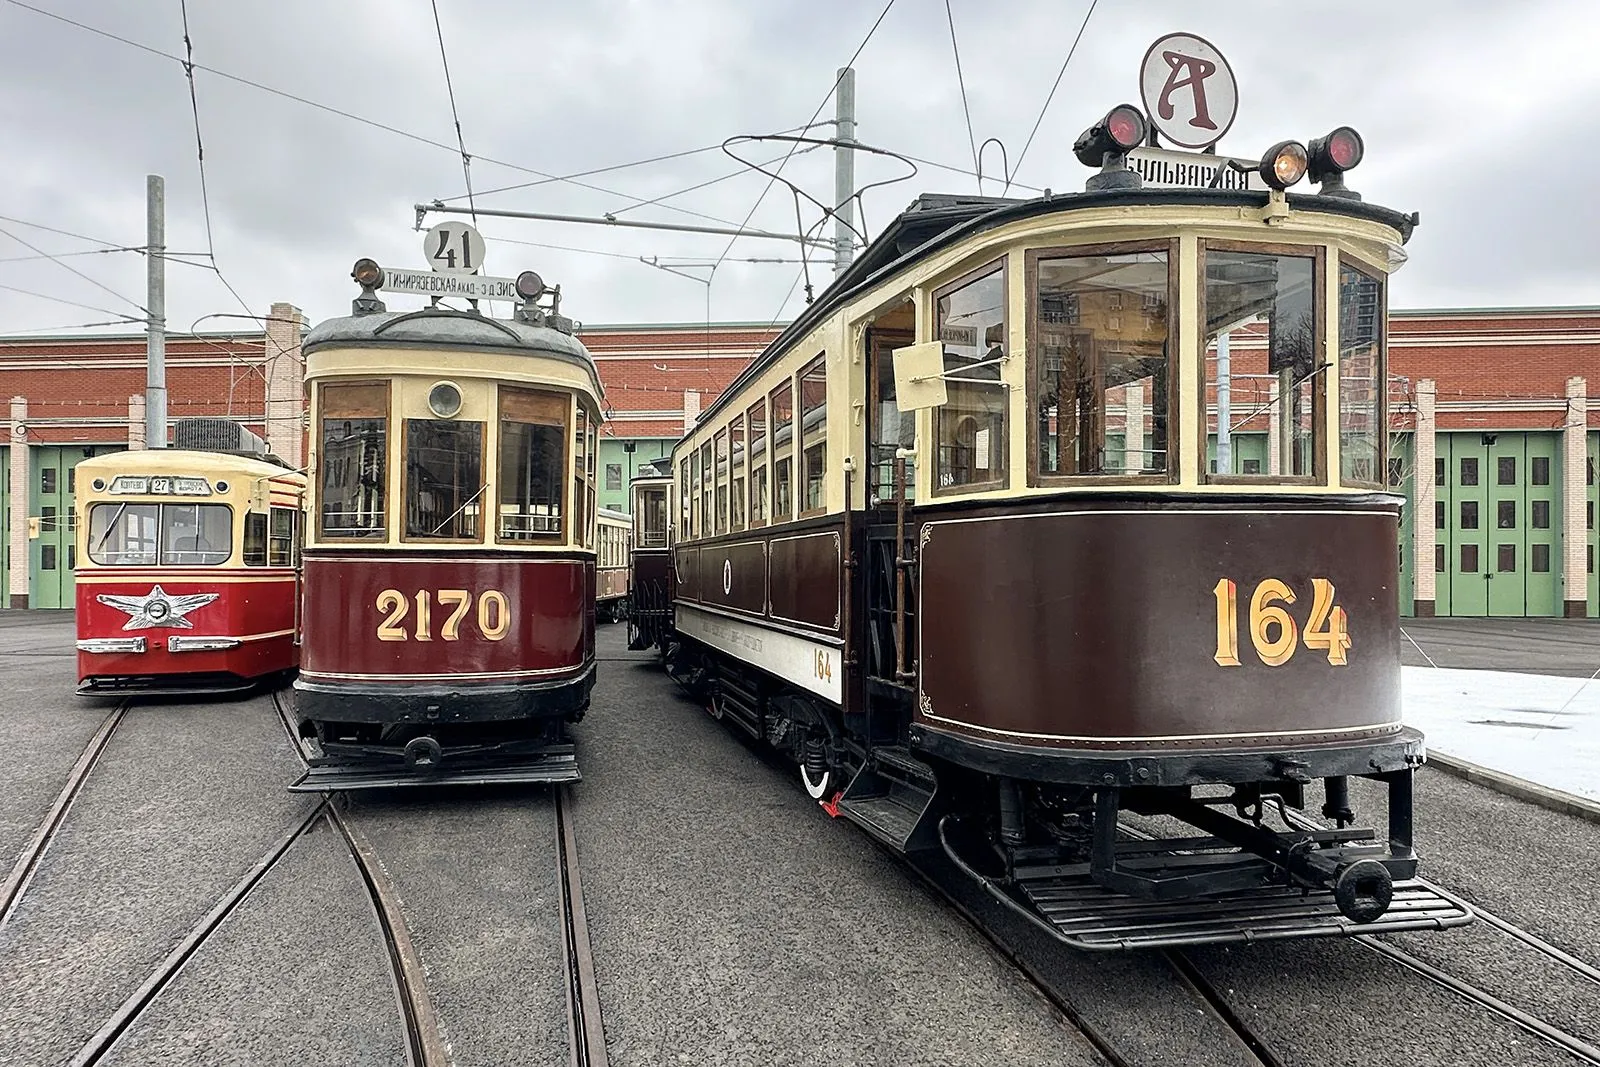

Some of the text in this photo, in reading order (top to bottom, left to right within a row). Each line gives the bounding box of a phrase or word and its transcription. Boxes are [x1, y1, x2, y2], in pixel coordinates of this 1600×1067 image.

[1157, 50, 1218, 130] А
[433, 230, 472, 268] 41
[388, 272, 457, 293] ТИМИРЯЗЕВСКАЯ
[496, 281, 515, 298] ЗИС
[154, 480, 167, 491] 27
[375, 589, 511, 641] 2170
[1213, 578, 1352, 667] 164
[813, 648, 832, 683] 164
